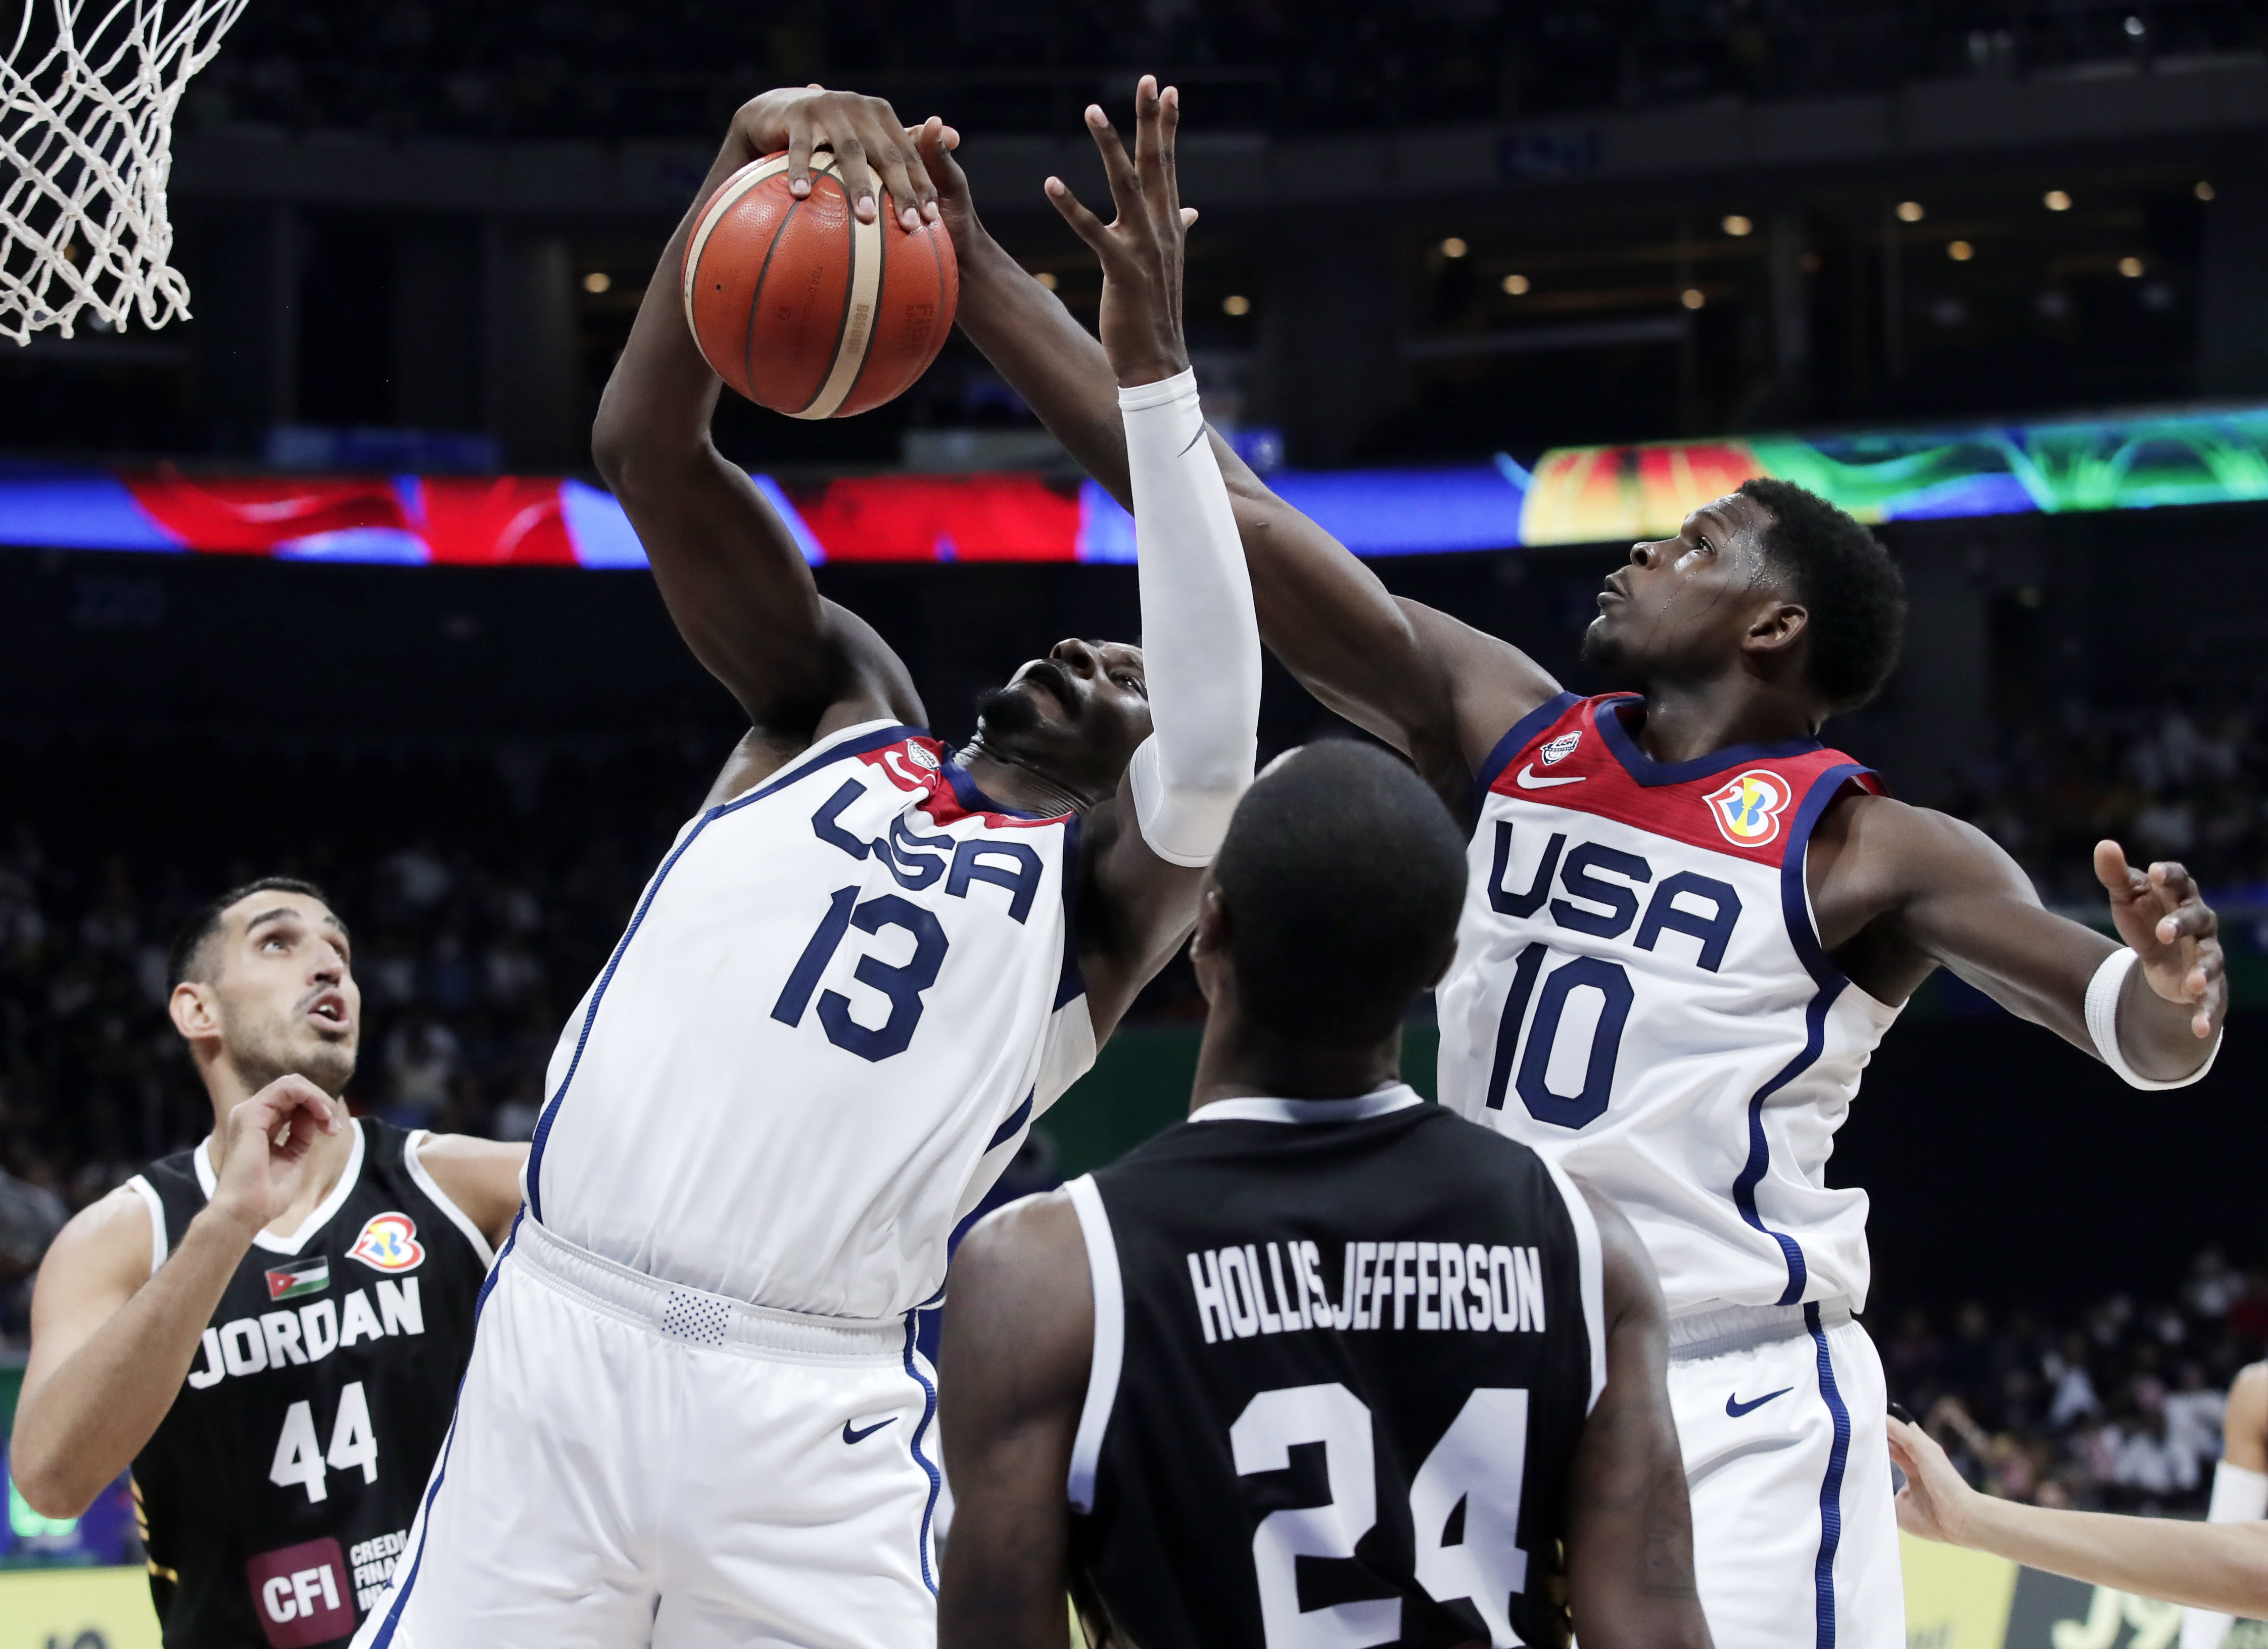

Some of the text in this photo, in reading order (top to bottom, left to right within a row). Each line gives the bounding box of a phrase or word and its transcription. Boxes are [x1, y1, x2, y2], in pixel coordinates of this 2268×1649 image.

[811, 777, 1044, 926] USA
[1487, 821, 1743, 973] USA
[770, 885, 949, 1062] 13
[1486, 942, 1635, 1130] 10
[187, 1277, 425, 1390] JORDAN
[269, 1380, 378, 1504] 44
[1230, 1382, 1529, 1649] 24
[262, 1563, 341, 1623] CFI
